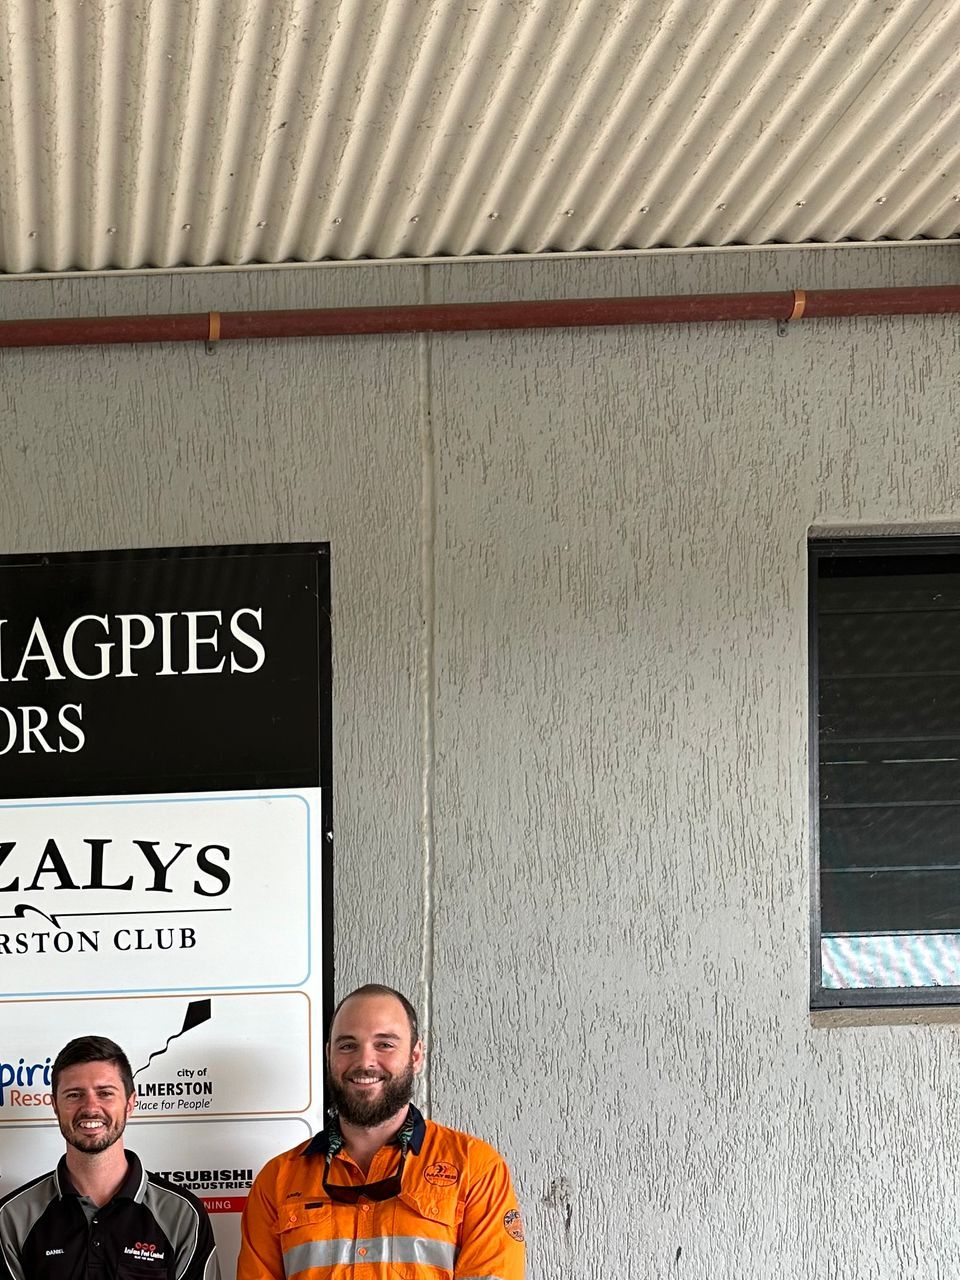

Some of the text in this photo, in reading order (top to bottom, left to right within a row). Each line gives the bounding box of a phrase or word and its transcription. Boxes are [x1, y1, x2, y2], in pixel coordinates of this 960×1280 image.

[113, 927, 196, 950] CLUB
[177, 1067, 207, 1078] city of
[137, 1082, 213, 1096] LMERSTON
[10, 1089, 53, 1107] Reso
[161, 1099, 175, 1111] for
[45, 1248, 65, 1256] DANIEL
